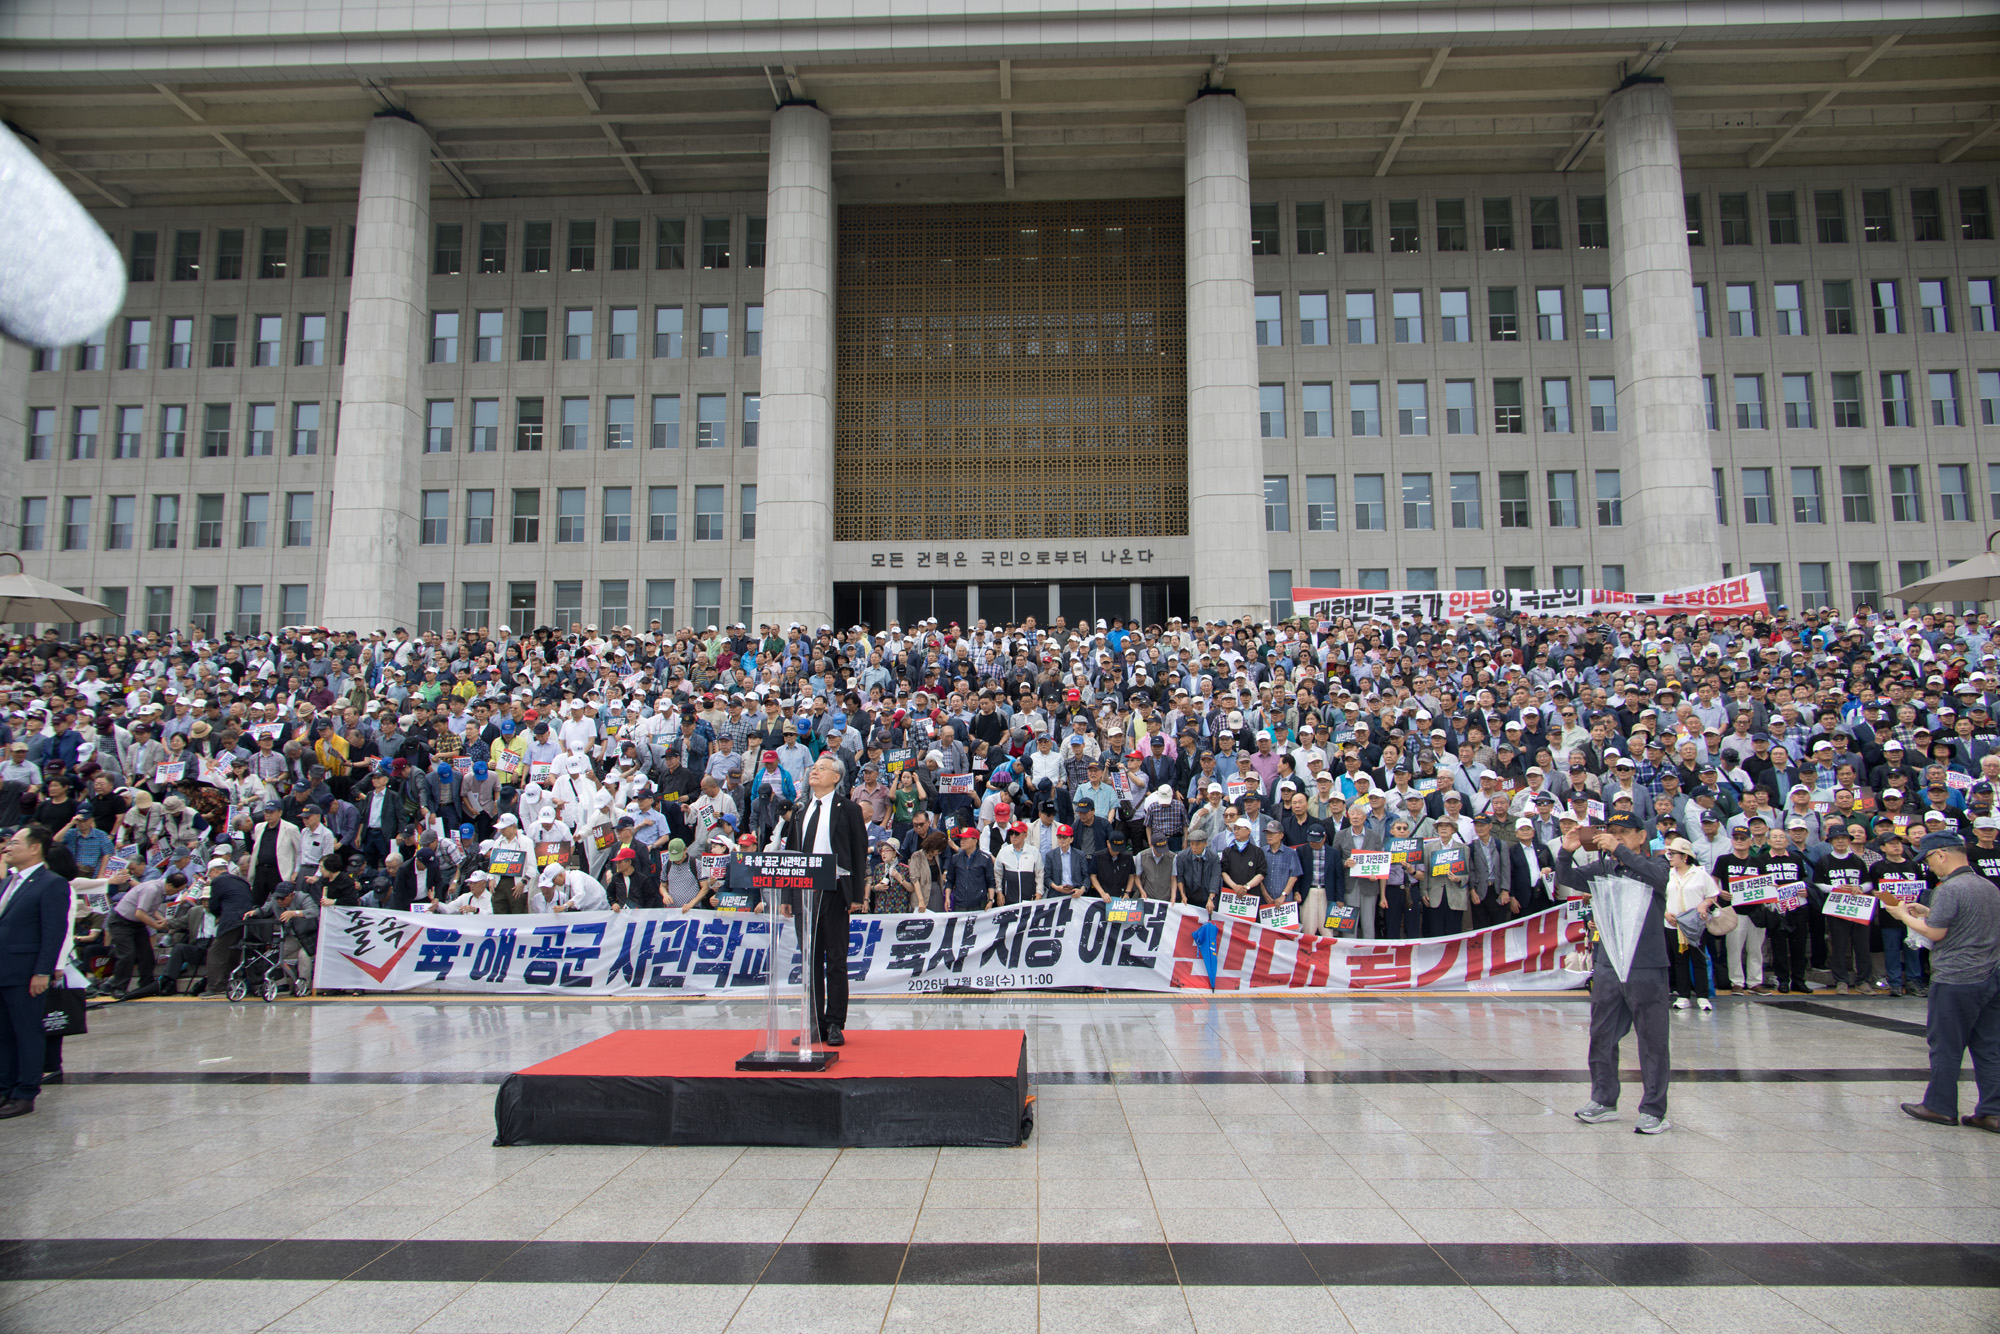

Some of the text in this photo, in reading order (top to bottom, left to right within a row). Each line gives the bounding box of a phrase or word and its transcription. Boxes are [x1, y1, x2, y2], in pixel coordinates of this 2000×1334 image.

[871, 548, 1154, 568] 모든 권력은 국민으로부터 나온다
[1310, 597, 1394, 624] 대한민국
[1402, 593, 1443, 618] 국가
[1449, 589, 1512, 617] 안보와
[889, 748, 912, 761] 사관학교
[887, 758, 916, 772] 통폐합 반대
[941, 776, 953, 785] 안보
[1229, 787, 1240, 795] 태릉
[1608, 814, 1630, 822] KMA
[547, 844, 561, 853] 육사
[1390, 839, 1417, 851] 사관학교
[494, 852, 521, 862] 사관학교
[558, 853, 569, 863] 반대
[1353, 854, 1389, 864] 태릉 자연환경
[1408, 850, 1422, 862] 반대
[1435, 849, 1460, 864] 사관학교
[702, 857, 714, 867] 안보
[744, 856, 823, 868] 육·해·공군 사관학교 통합
[1765, 863, 1782, 872] 육사
[1978, 859, 1995, 867] 육사
[489, 863, 522, 874] 통폐합 반대
[761, 868, 806, 877] 육사 지방 이전
[1361, 865, 1380, 875] 보전
[1432, 860, 1465, 876] 통폐합 반대
[1727, 864, 1743, 874] 육사
[1828, 869, 1845, 878] 육사
[752, 876, 814, 889] 반대 궐기대회
[1731, 875, 1773, 893] 태릉 자연환경
[1881, 882, 1895, 892] 안보
[1222, 894, 1258, 907] 태릉 안보성지
[1743, 889, 1765, 901] 보전
[1829, 893, 1872, 908] 태릉 자연환경
[720, 896, 748, 907] 사관학교
[1112, 900, 1138, 910] 사관학교
[1228, 904, 1247, 915] 보존
[1261, 904, 1296, 919] 태릉 안보성지
[1835, 904, 1858, 916] 보전
[1108, 911, 1142, 922] 통폐합 반대
[1271, 917, 1289, 927] 보존
[1325, 917, 1355, 929] 통폐합 반대
[344, 910, 410, 957] 졸속
[415, 922, 607, 988] 육·해·공군
[607, 919, 784, 988] 사관학교
[886, 912, 979, 982] 육사
[980, 898, 1074, 970] 지방
[1078, 902, 1170, 970] 이전
[1170, 914, 1338, 990] 반대
[907, 977, 949, 992] 2026년
[976, 973, 1015, 987] 8일(수)
[1020, 973, 1053, 985] 11:00
